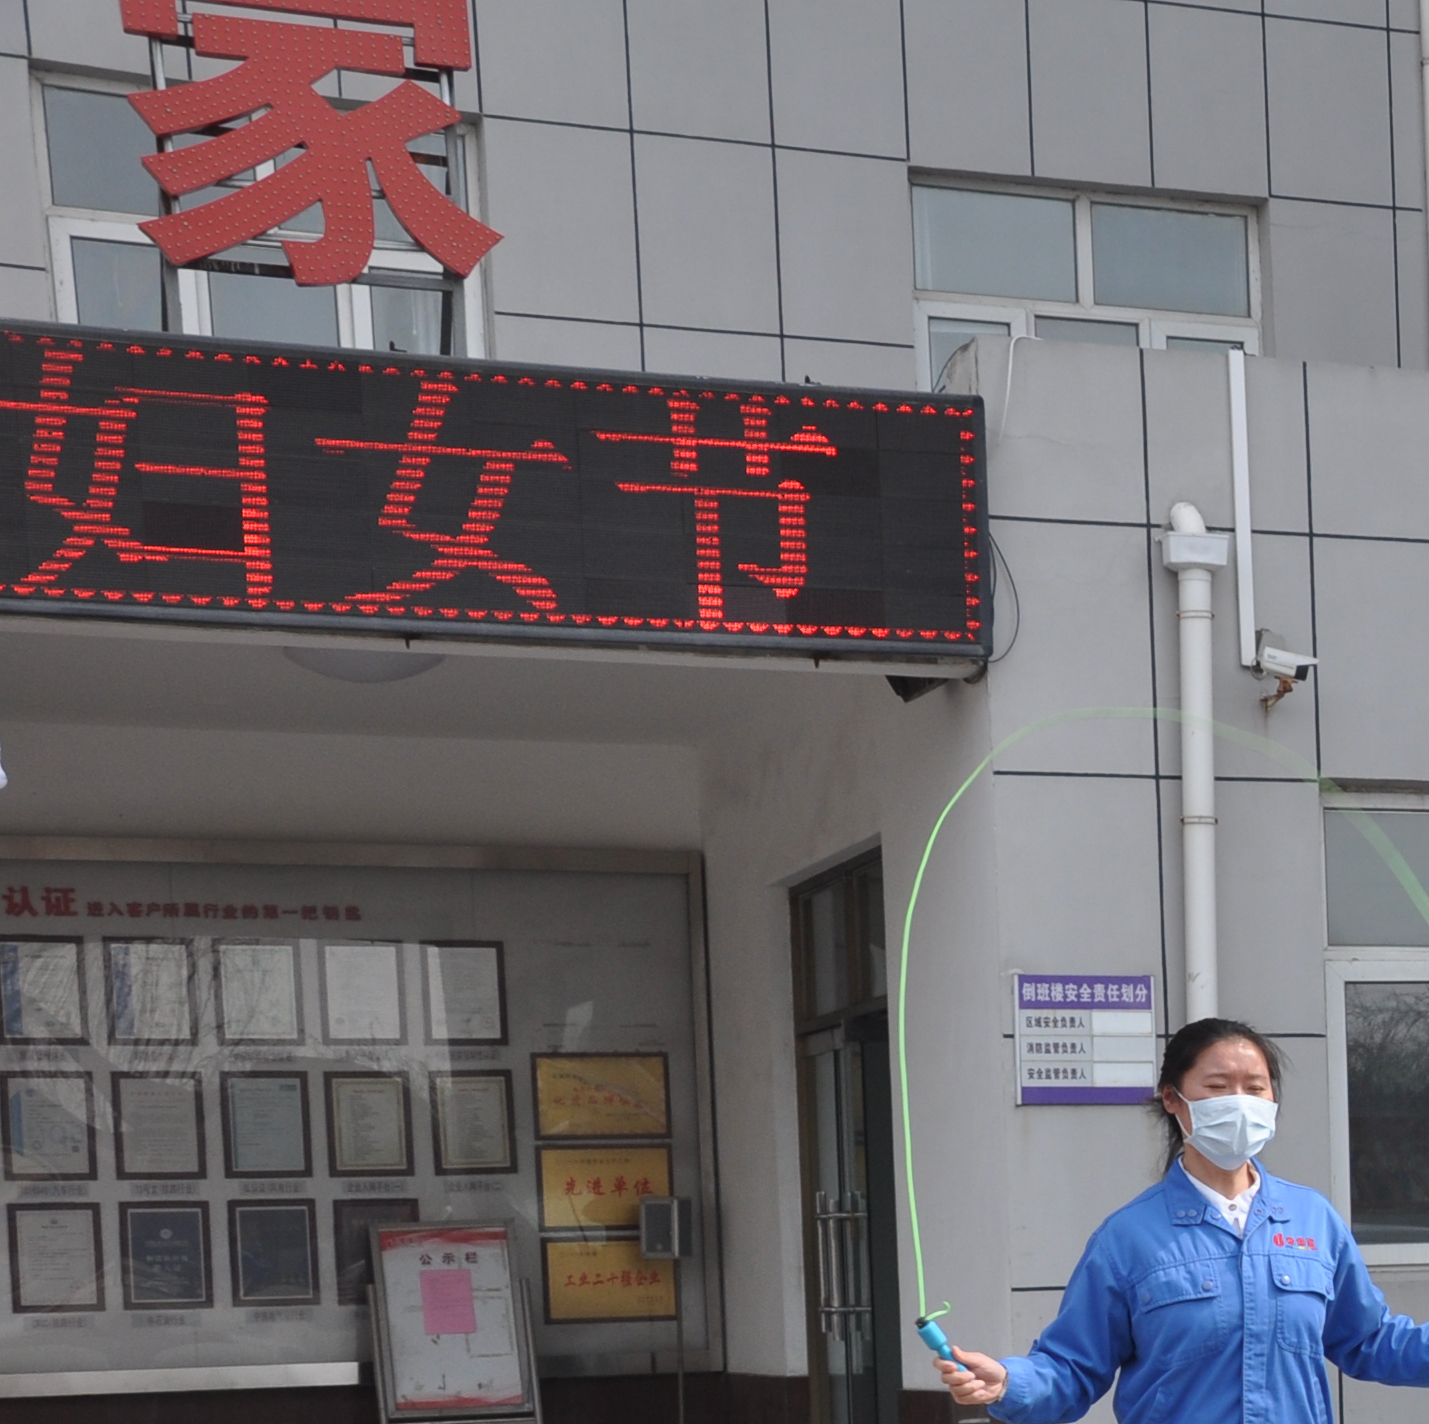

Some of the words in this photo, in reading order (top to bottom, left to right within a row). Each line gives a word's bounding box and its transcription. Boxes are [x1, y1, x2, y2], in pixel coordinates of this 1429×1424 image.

[0, 349, 838, 630] 妇女节
[3, 886, 78, 917] 认证
[1022, 983, 1148, 1003] 倒班楼安全责任划分
[1026, 1016, 1085, 1029] 区域安全负责人
[1027, 1042, 1086, 1054] 消防监管负责人
[1027, 1068, 1087, 1080] 安全监管负责人
[564, 1175, 653, 1197] 先进单位
[419, 1252, 478, 1265] 公示栏
